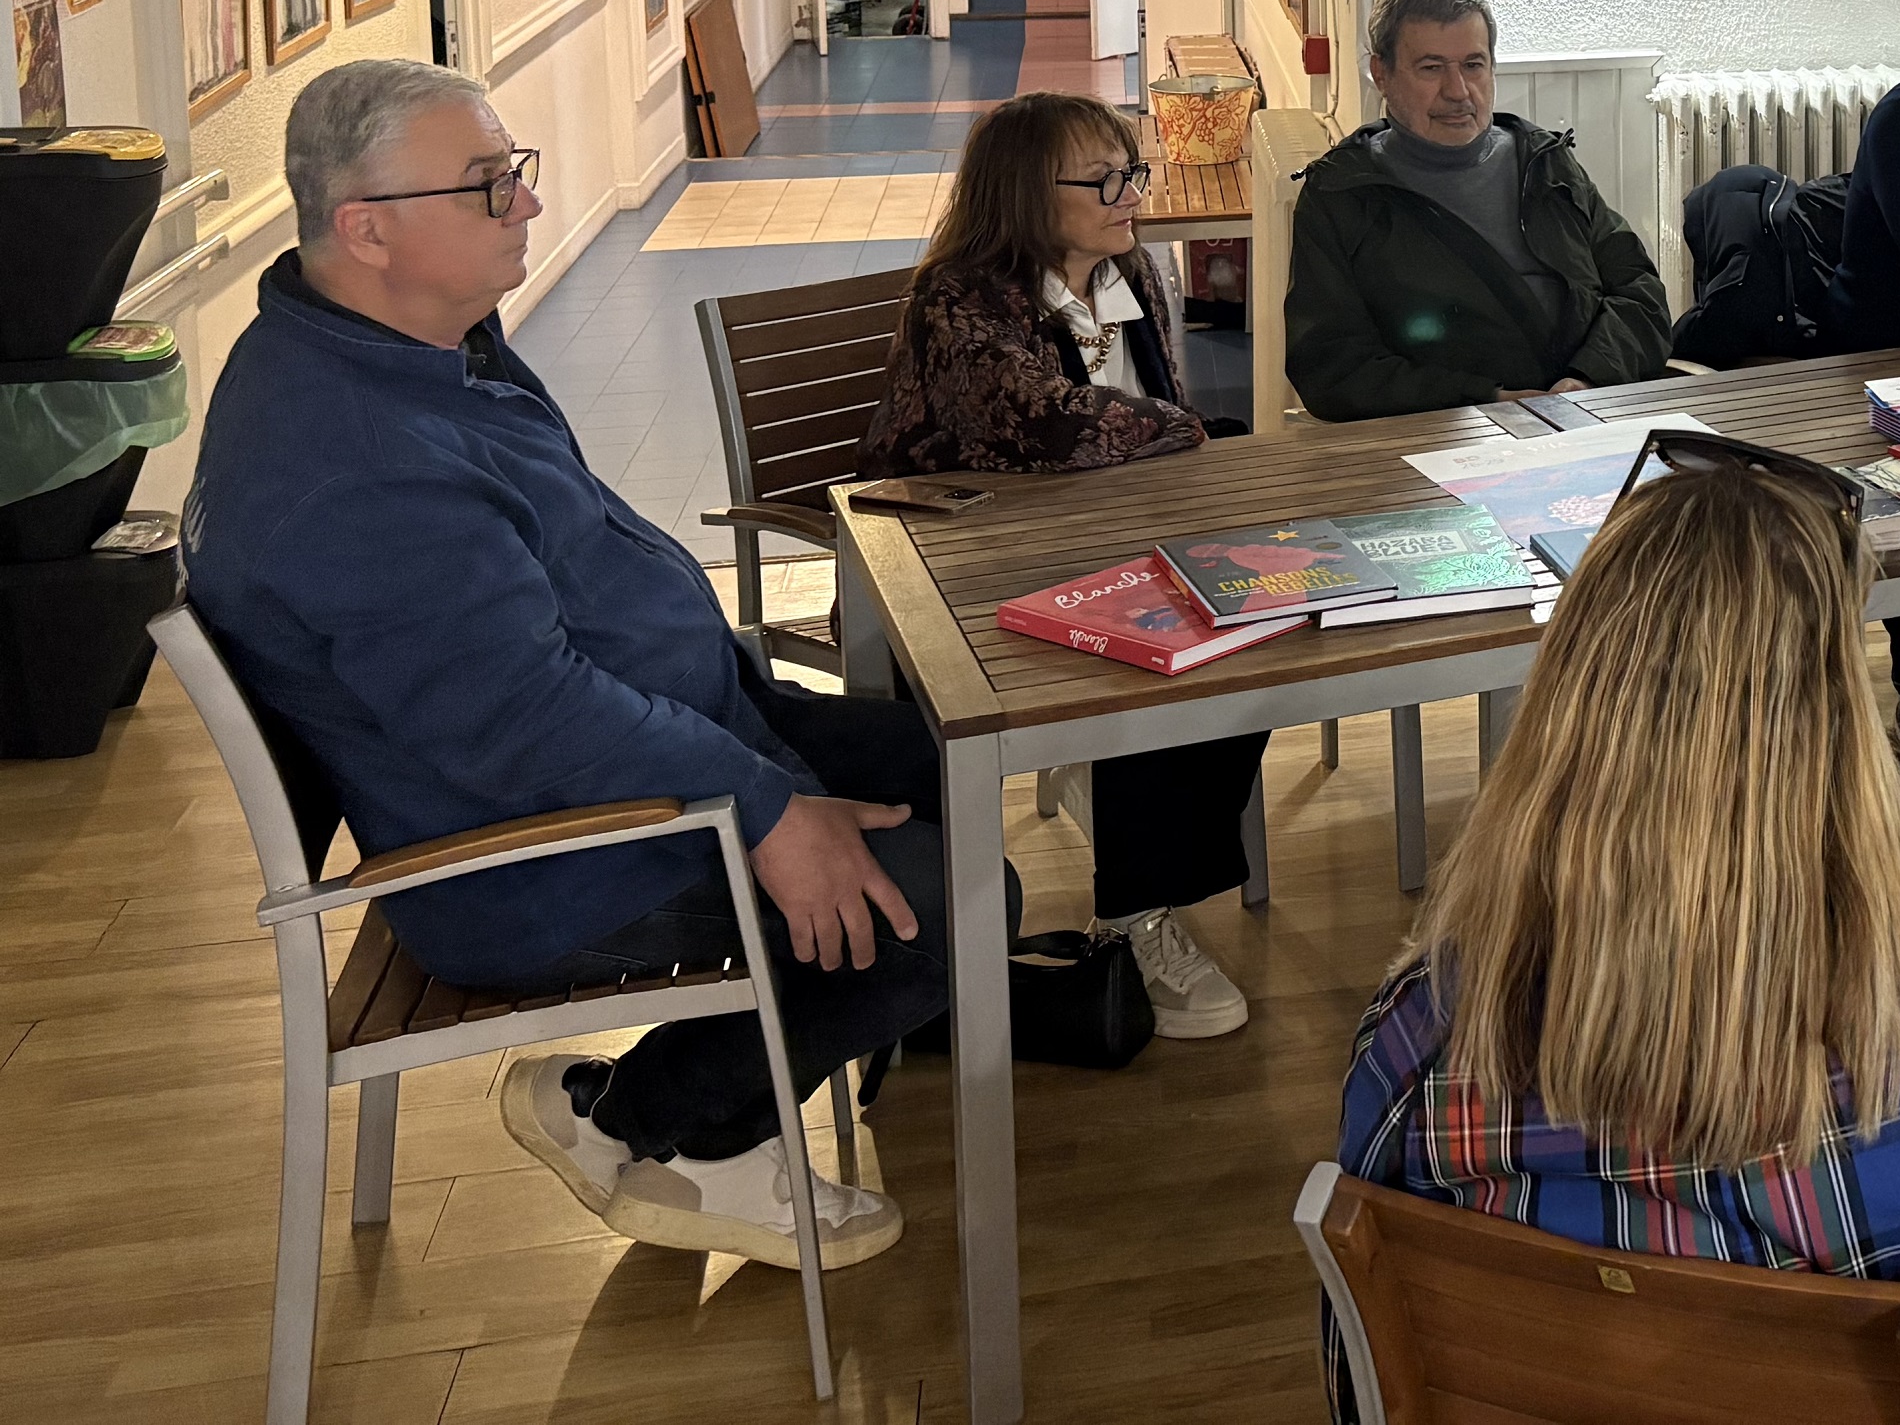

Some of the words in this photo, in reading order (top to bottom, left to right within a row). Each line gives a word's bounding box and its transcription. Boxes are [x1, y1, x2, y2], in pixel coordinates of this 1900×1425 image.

[1360, 534, 1455, 551] HAZARA
[1364, 543, 1458, 559] BLUES
[1054, 571, 1161, 610] Blanche
[1217, 566, 1334, 593] CHANSONS
[1264, 573, 1360, 596] REBELLES
[1068, 628, 1109, 654] Blanche
